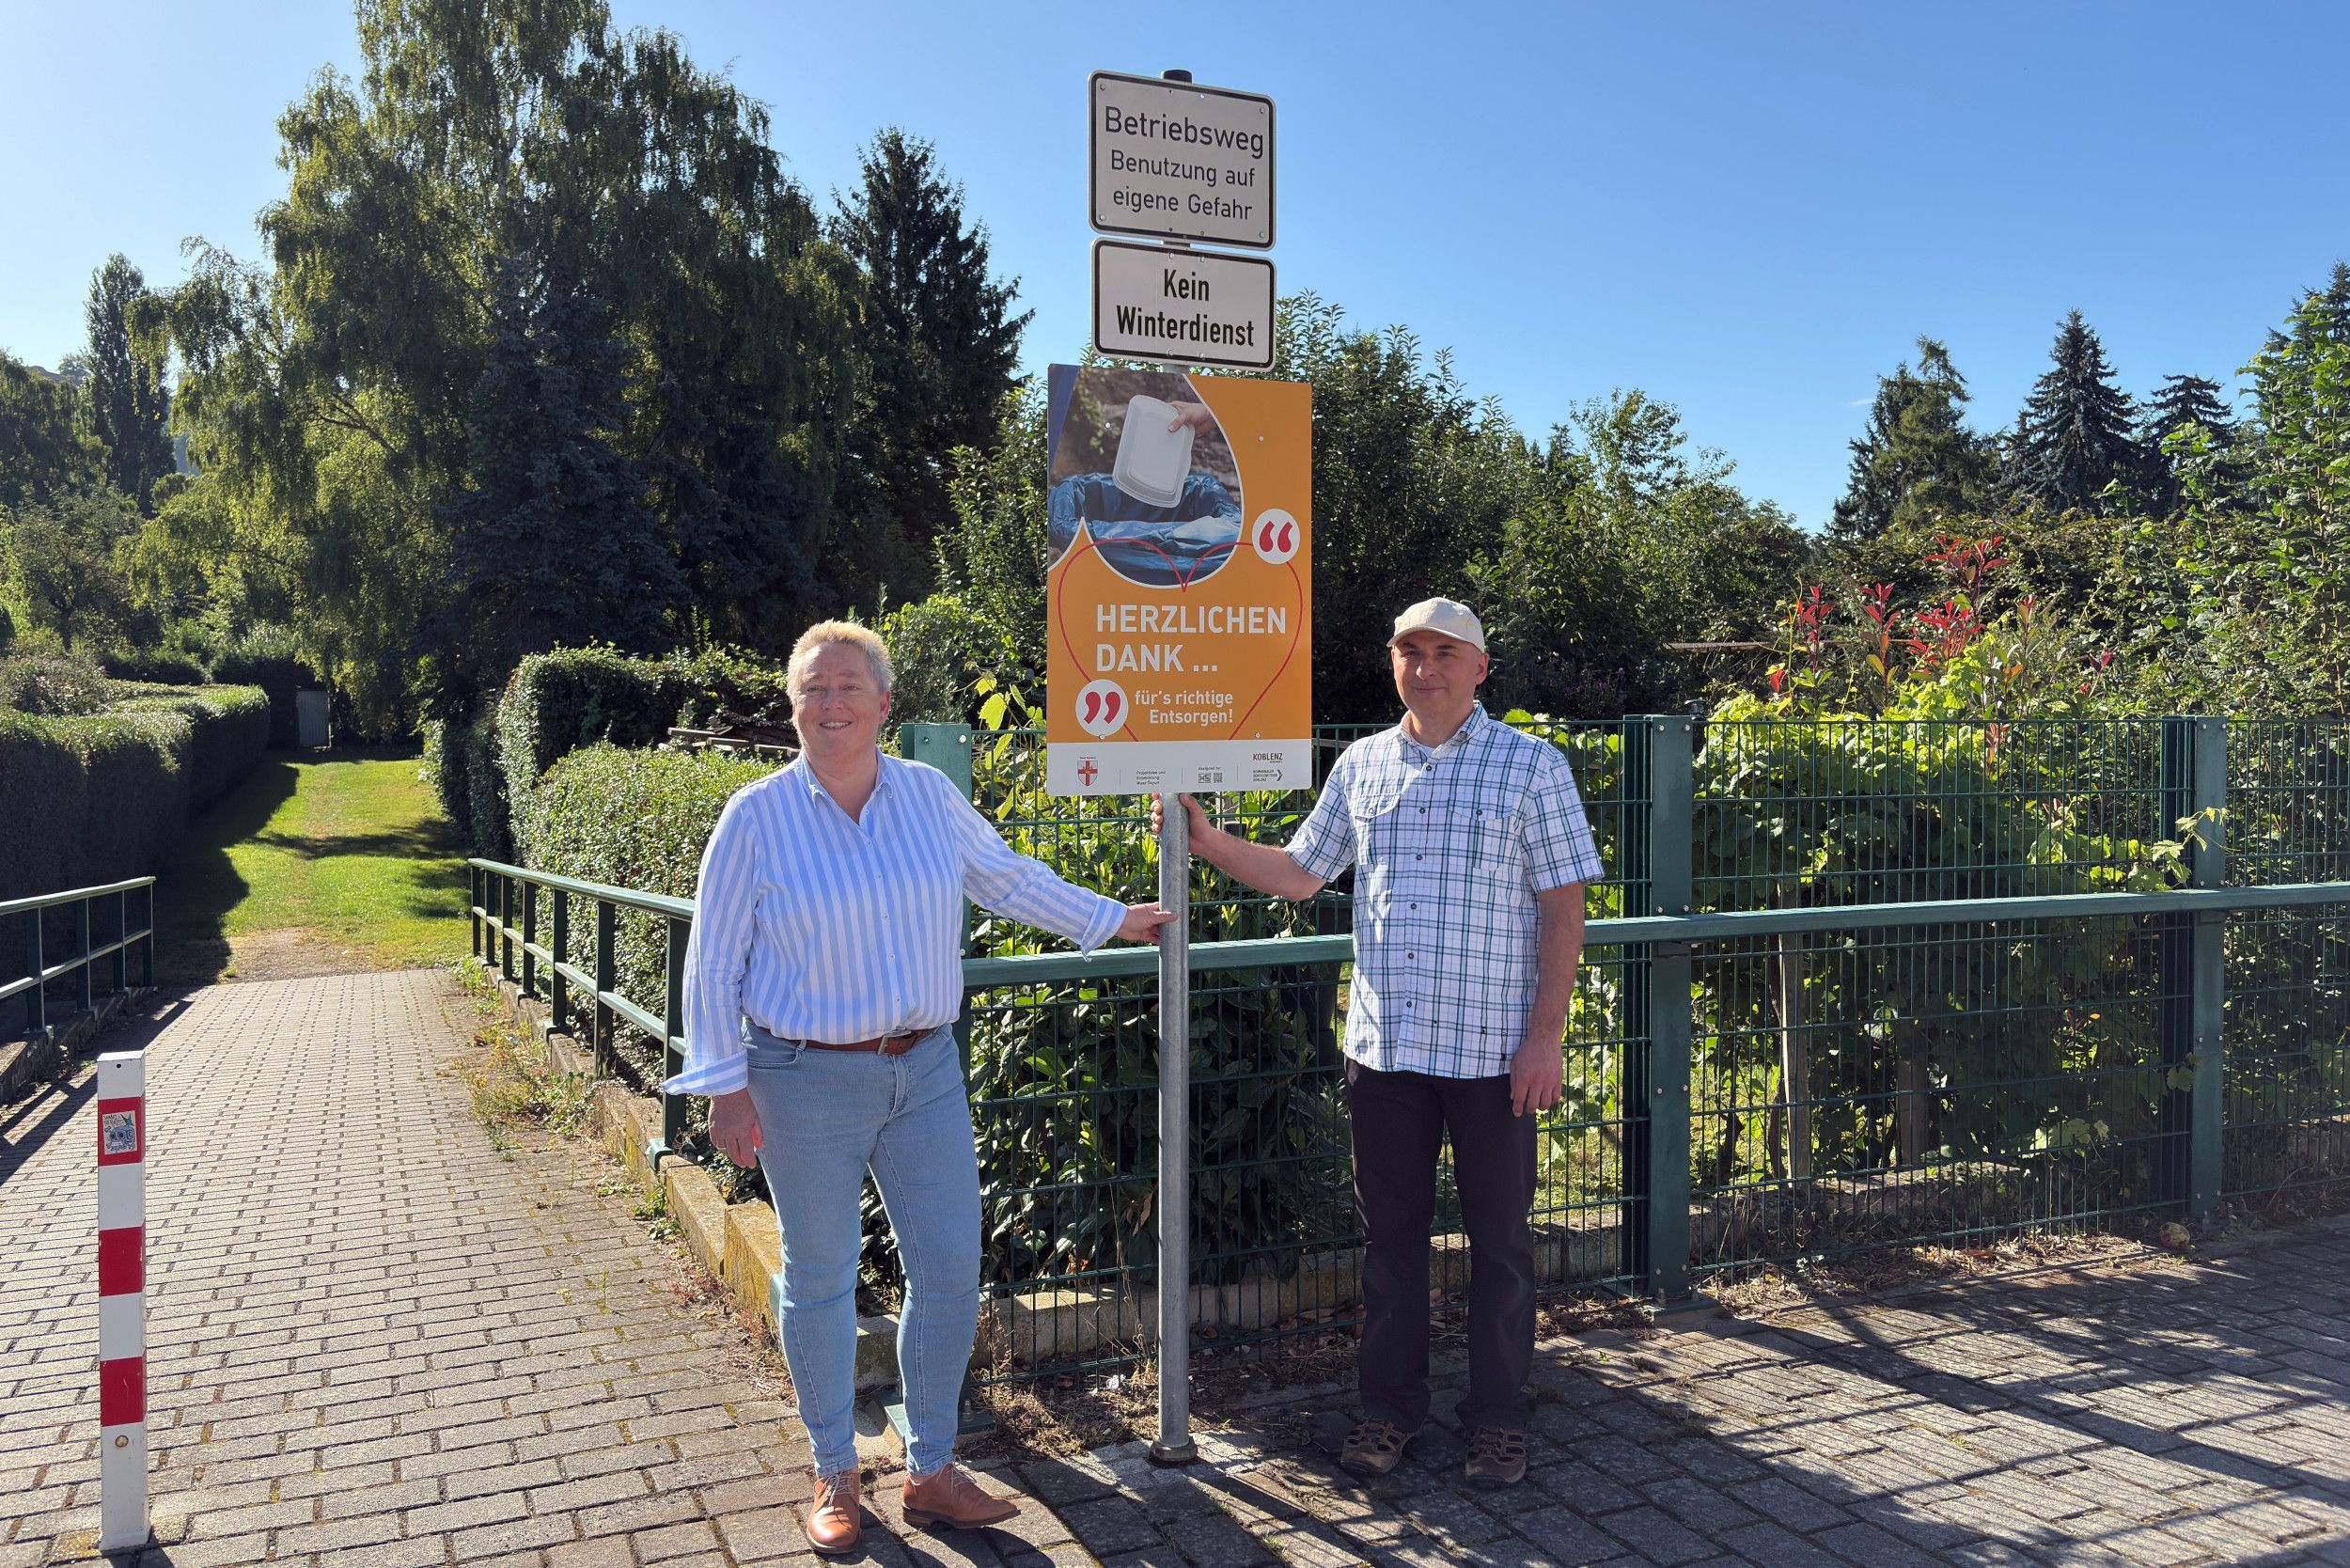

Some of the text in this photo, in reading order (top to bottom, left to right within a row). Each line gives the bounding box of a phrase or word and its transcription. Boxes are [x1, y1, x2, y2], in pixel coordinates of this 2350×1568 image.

[1104, 105, 1264, 159] Betriebsweg
[1111, 149, 1256, 187] Benutzung auf
[1113, 186, 1252, 220] eigene Gefahr
[1164, 268, 1210, 301] Kein
[1116, 305, 1254, 347] Winterdienst
[1096, 604, 1286, 634] HERZLICHEN
[1096, 643, 1184, 672] DANK
[1175, 690, 1234, 708] richtige
[1150, 709, 1234, 727] Entsorgen!
[1252, 752, 1283, 761] KOBLENZ
